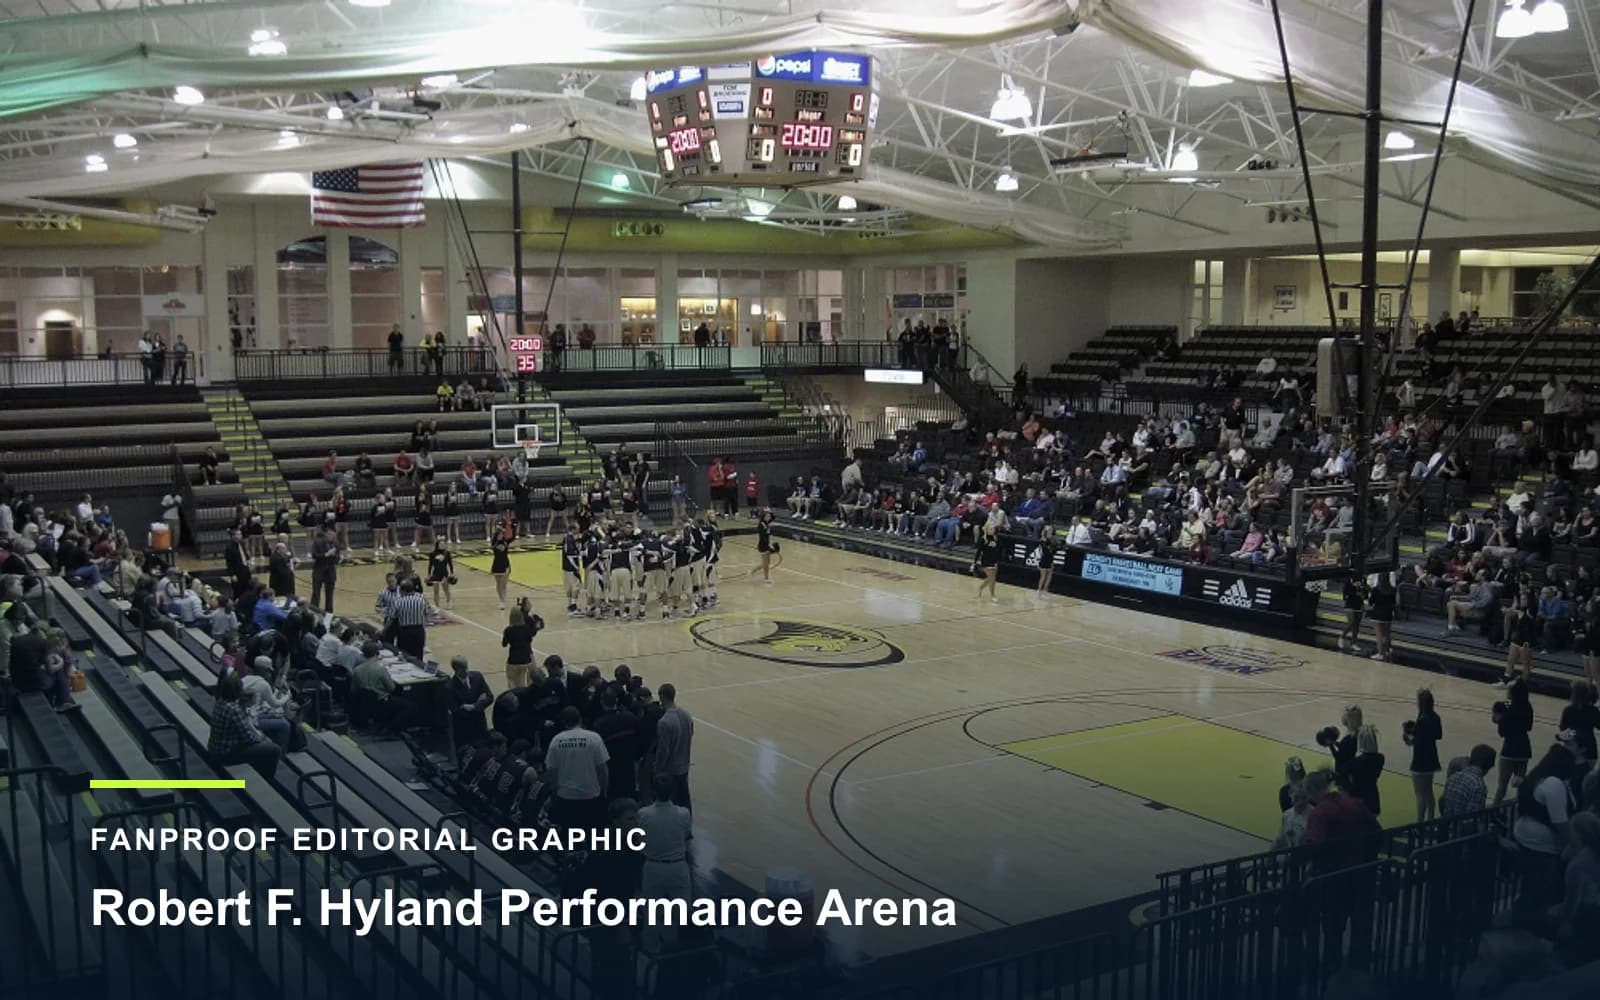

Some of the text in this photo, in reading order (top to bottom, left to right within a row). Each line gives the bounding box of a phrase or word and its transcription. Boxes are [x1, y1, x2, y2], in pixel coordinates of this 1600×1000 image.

[776, 59, 811, 75] pepsi
[762, 88, 773, 105] 0
[852, 95, 864, 111] 0
[670, 128, 700, 152] 20:00
[782, 124, 832, 147] 20:00
[761, 138, 775, 162] 0
[848, 143, 862, 166] 0
[510, 338, 541, 350] 20:00
[518, 355, 534, 371] 35
[1219, 594, 1253, 609] adidas
